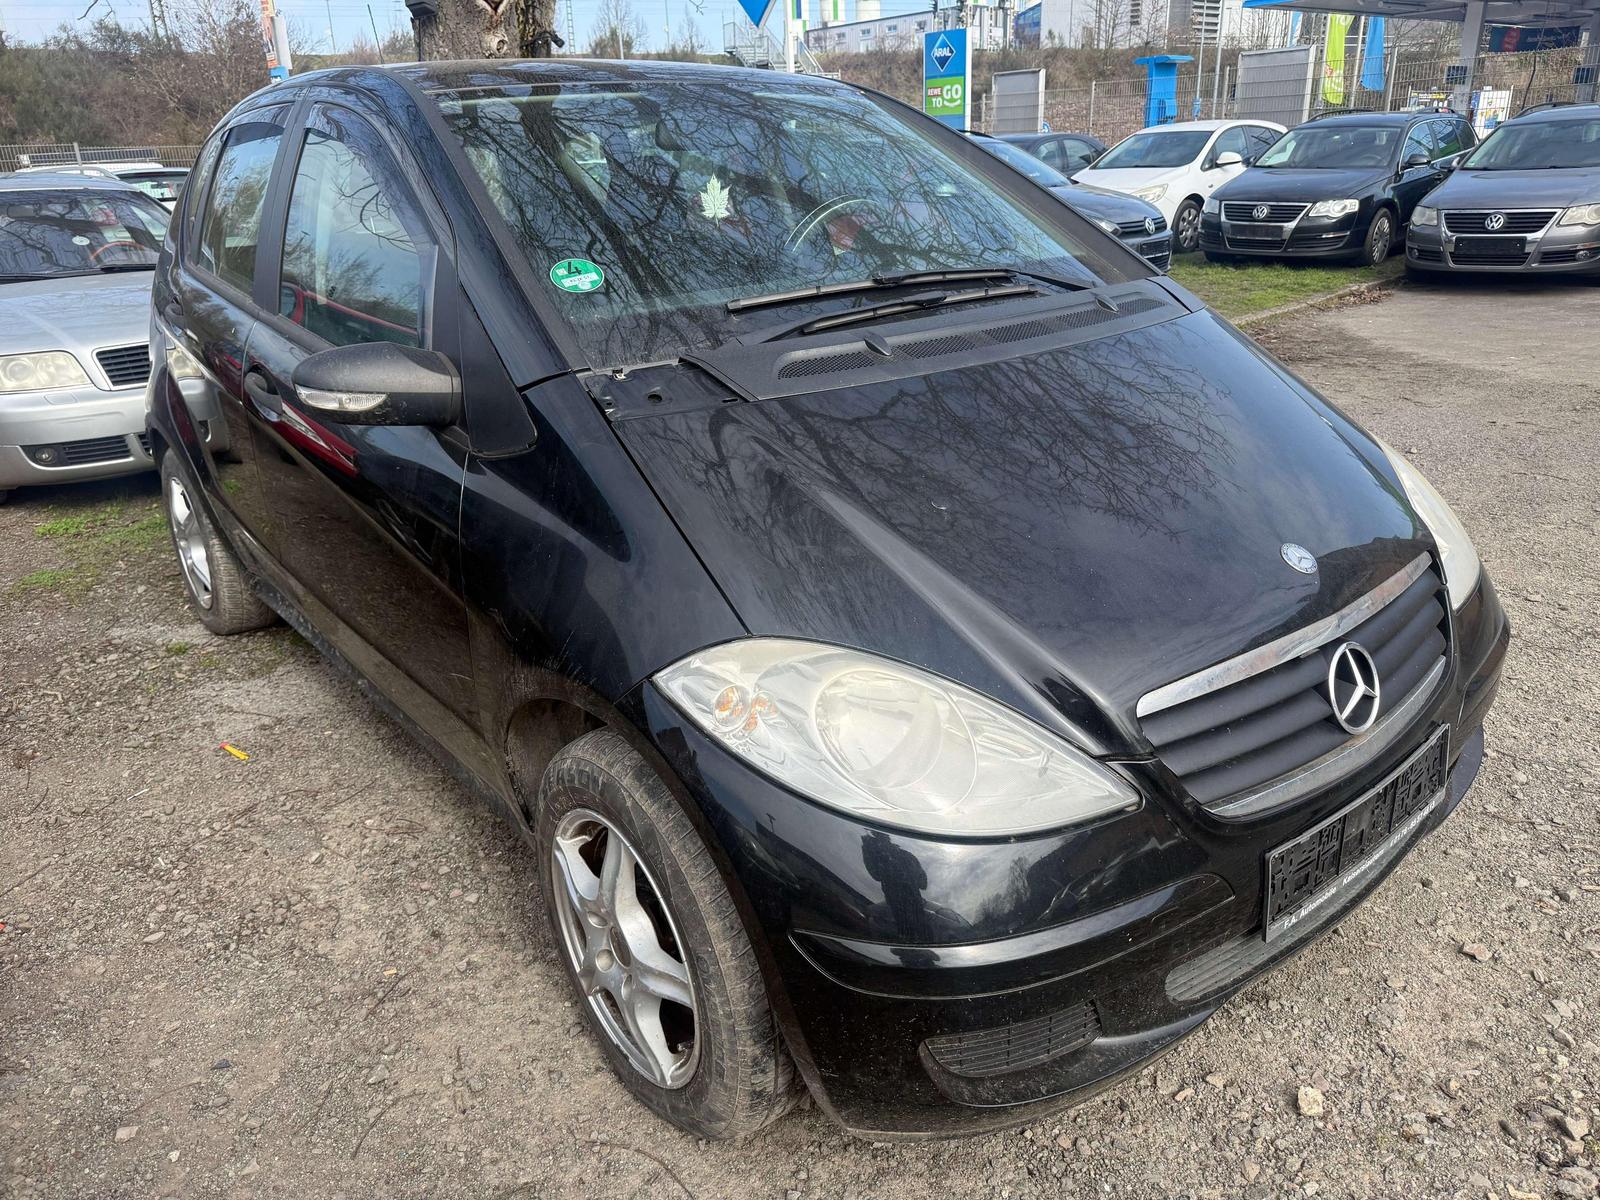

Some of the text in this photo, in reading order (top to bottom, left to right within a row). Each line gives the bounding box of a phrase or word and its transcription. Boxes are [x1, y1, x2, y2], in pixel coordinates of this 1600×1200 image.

[933, 46, 952, 57] ARAL
[943, 84, 962, 99] GO
[932, 98, 943, 108] TO
